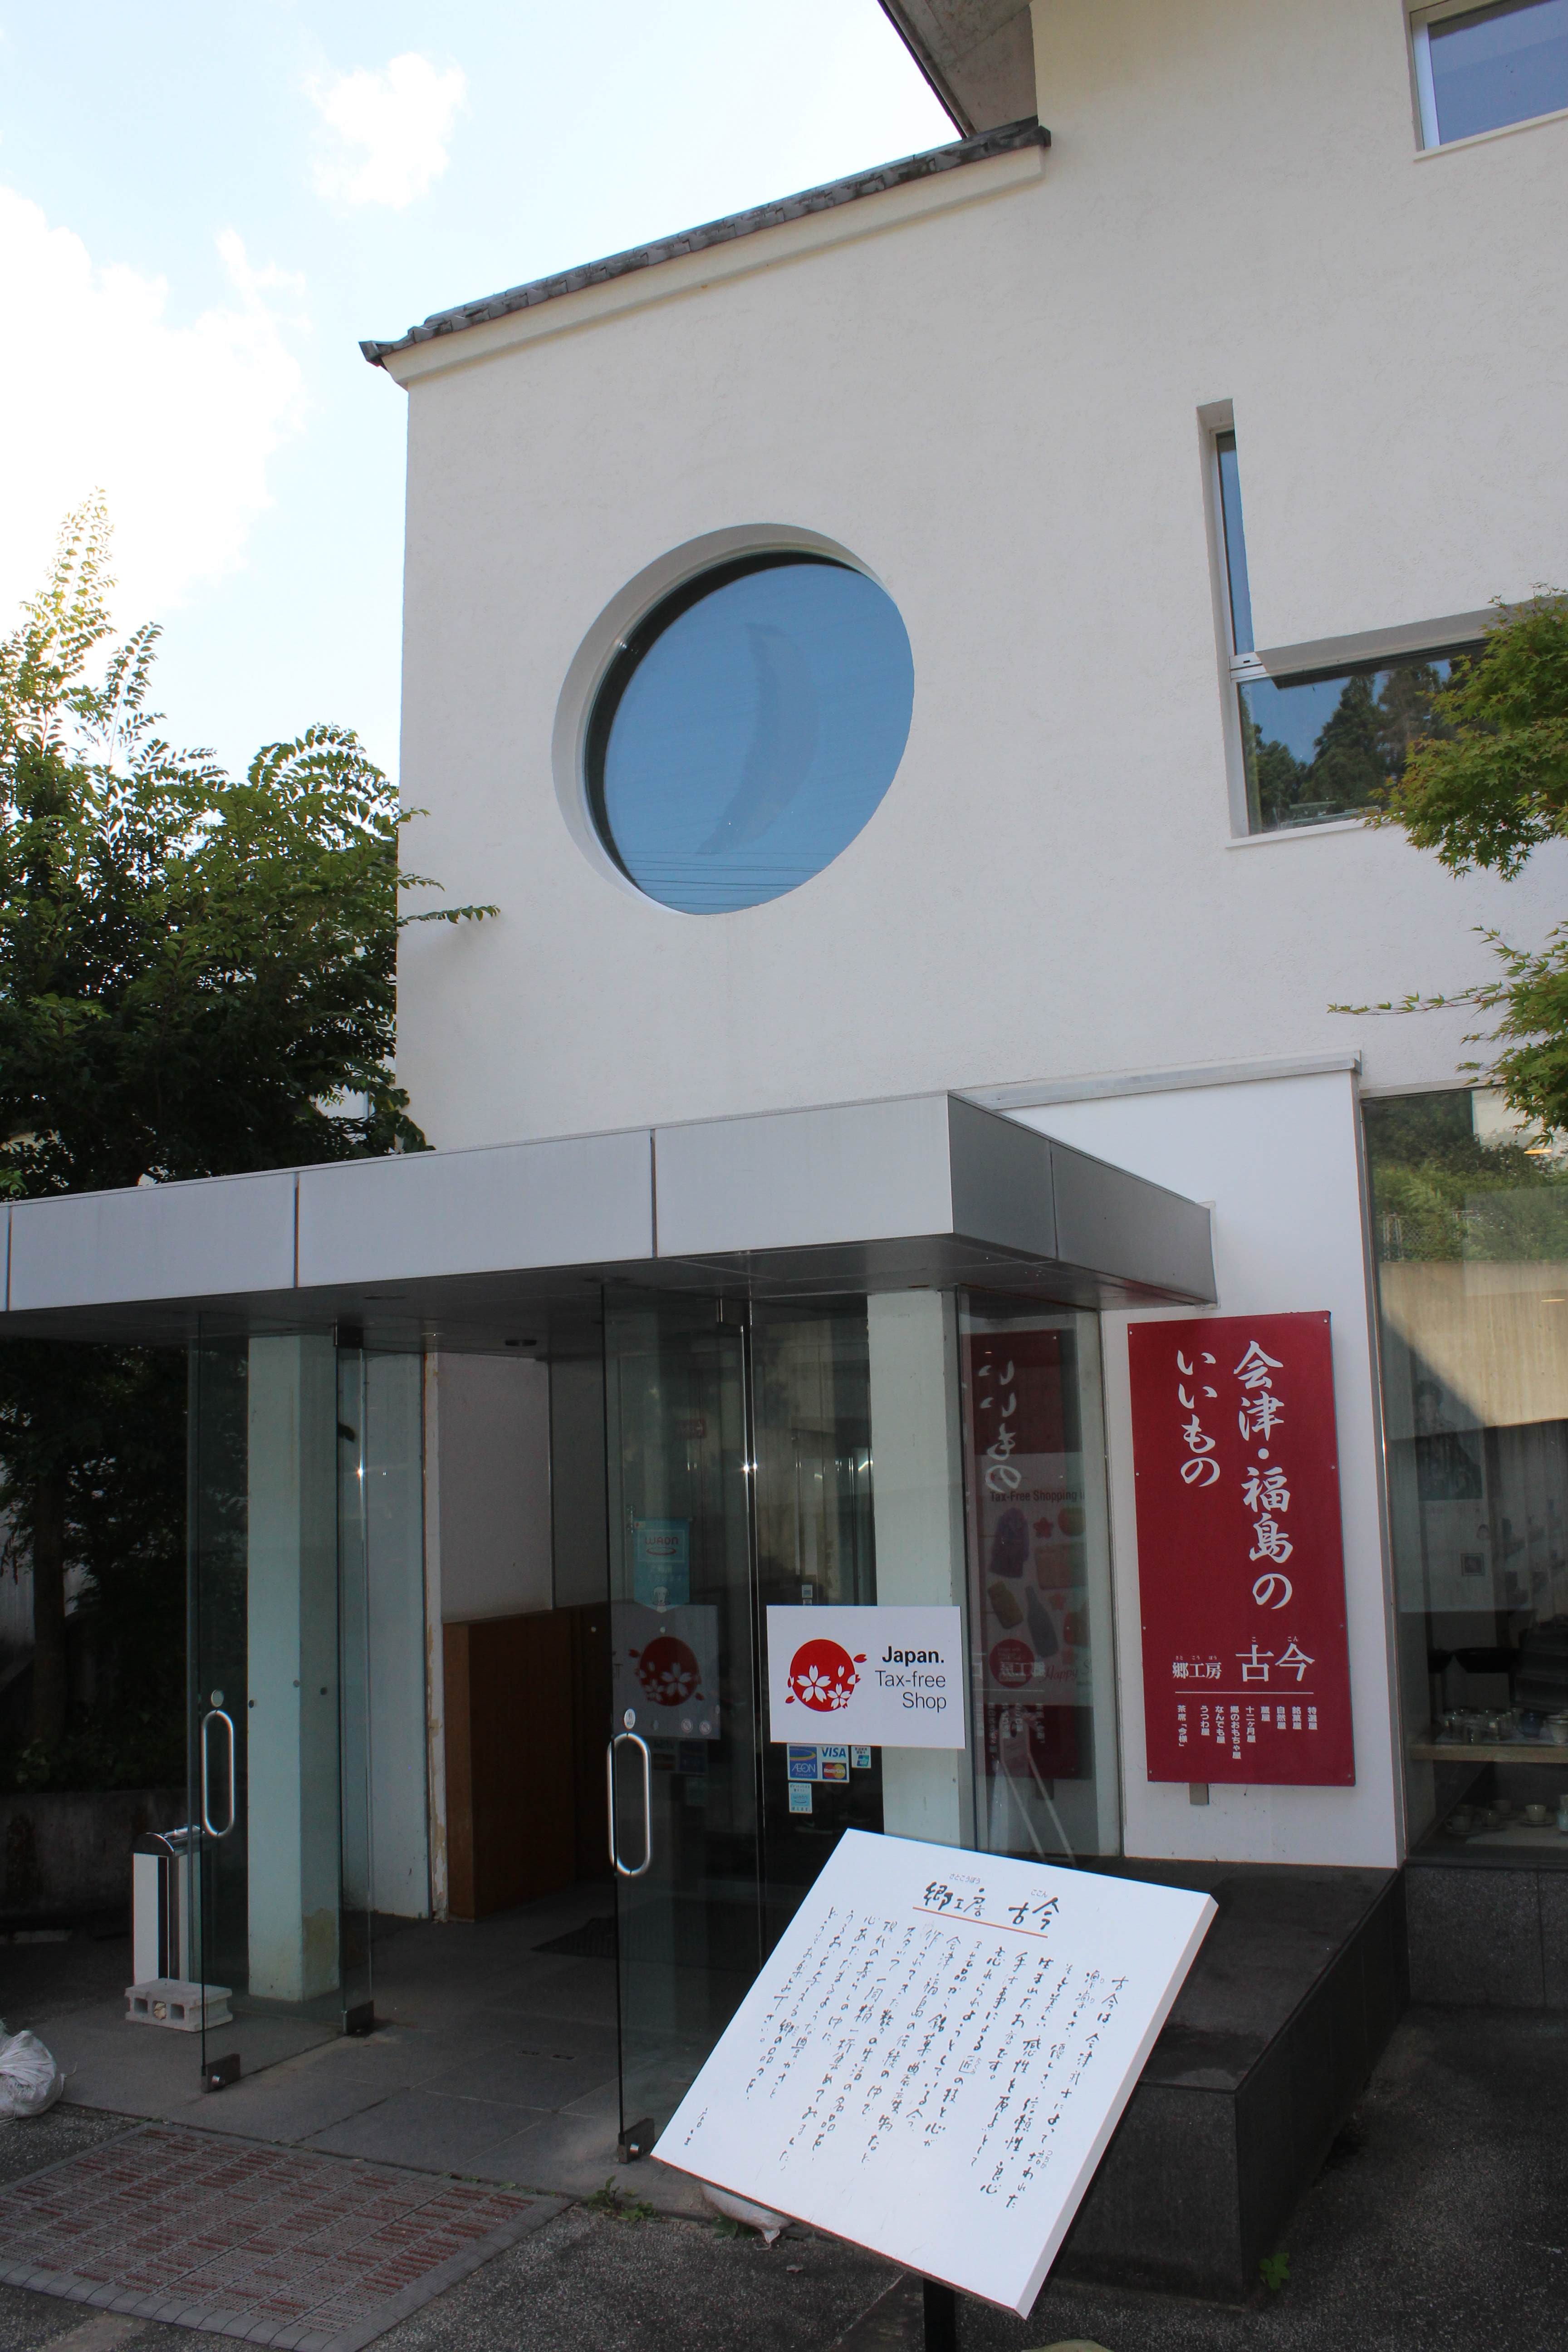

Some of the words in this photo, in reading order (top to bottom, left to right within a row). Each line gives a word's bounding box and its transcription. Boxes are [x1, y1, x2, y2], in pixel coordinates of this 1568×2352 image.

[1177, 1350, 1220, 1486] いいもの
[1234, 1341, 1293, 1609] 会津・福島の
[990, 1490, 1031, 1502] Tax-Free
[1033, 1490, 1078, 1503] Shopping
[882, 1646, 944, 1666] Japan.
[1172, 1662, 1221, 1679] 郷工房
[1236, 1643, 1314, 1681] 古今
[875, 1671, 946, 1687] Tax-free
[902, 1692, 946, 1712] Shop
[1201, 1705, 1210, 1735] うつわ屋
[1215, 1706, 1225, 1743] なんでも屋
[822, 1747, 846, 1757] VISA
[923, 1881, 985, 1916] 郷工房
[1008, 1897, 1059, 1930] 古今
